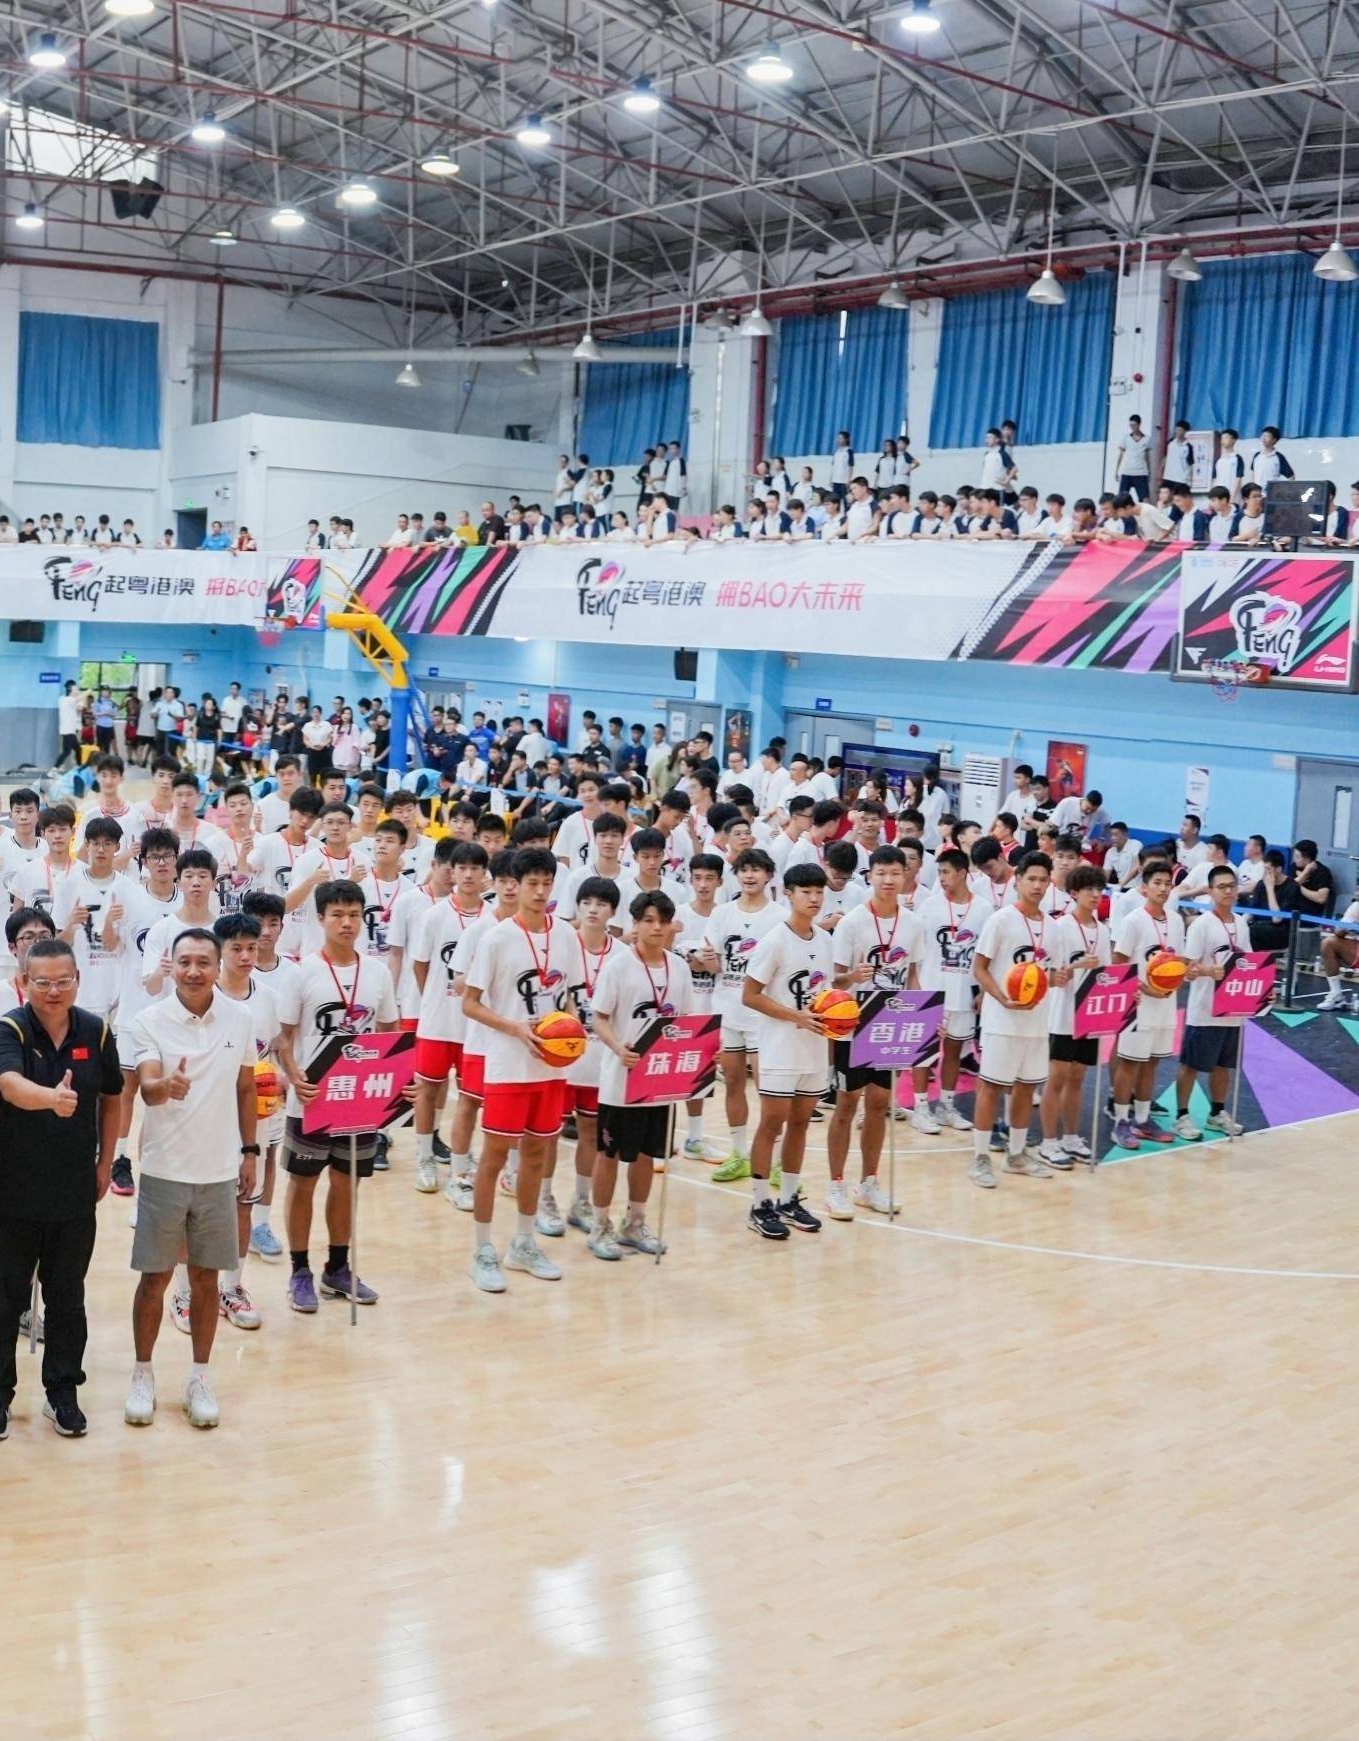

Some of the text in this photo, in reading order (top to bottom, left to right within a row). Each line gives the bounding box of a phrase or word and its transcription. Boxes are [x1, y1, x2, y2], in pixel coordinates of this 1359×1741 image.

[1225, 979, 1263, 996] 中山
[1086, 993, 1127, 1015] 江门
[869, 1022, 925, 1043] 香港
[645, 1050, 703, 1076] 珠海
[325, 1073, 394, 1101] 惠州
